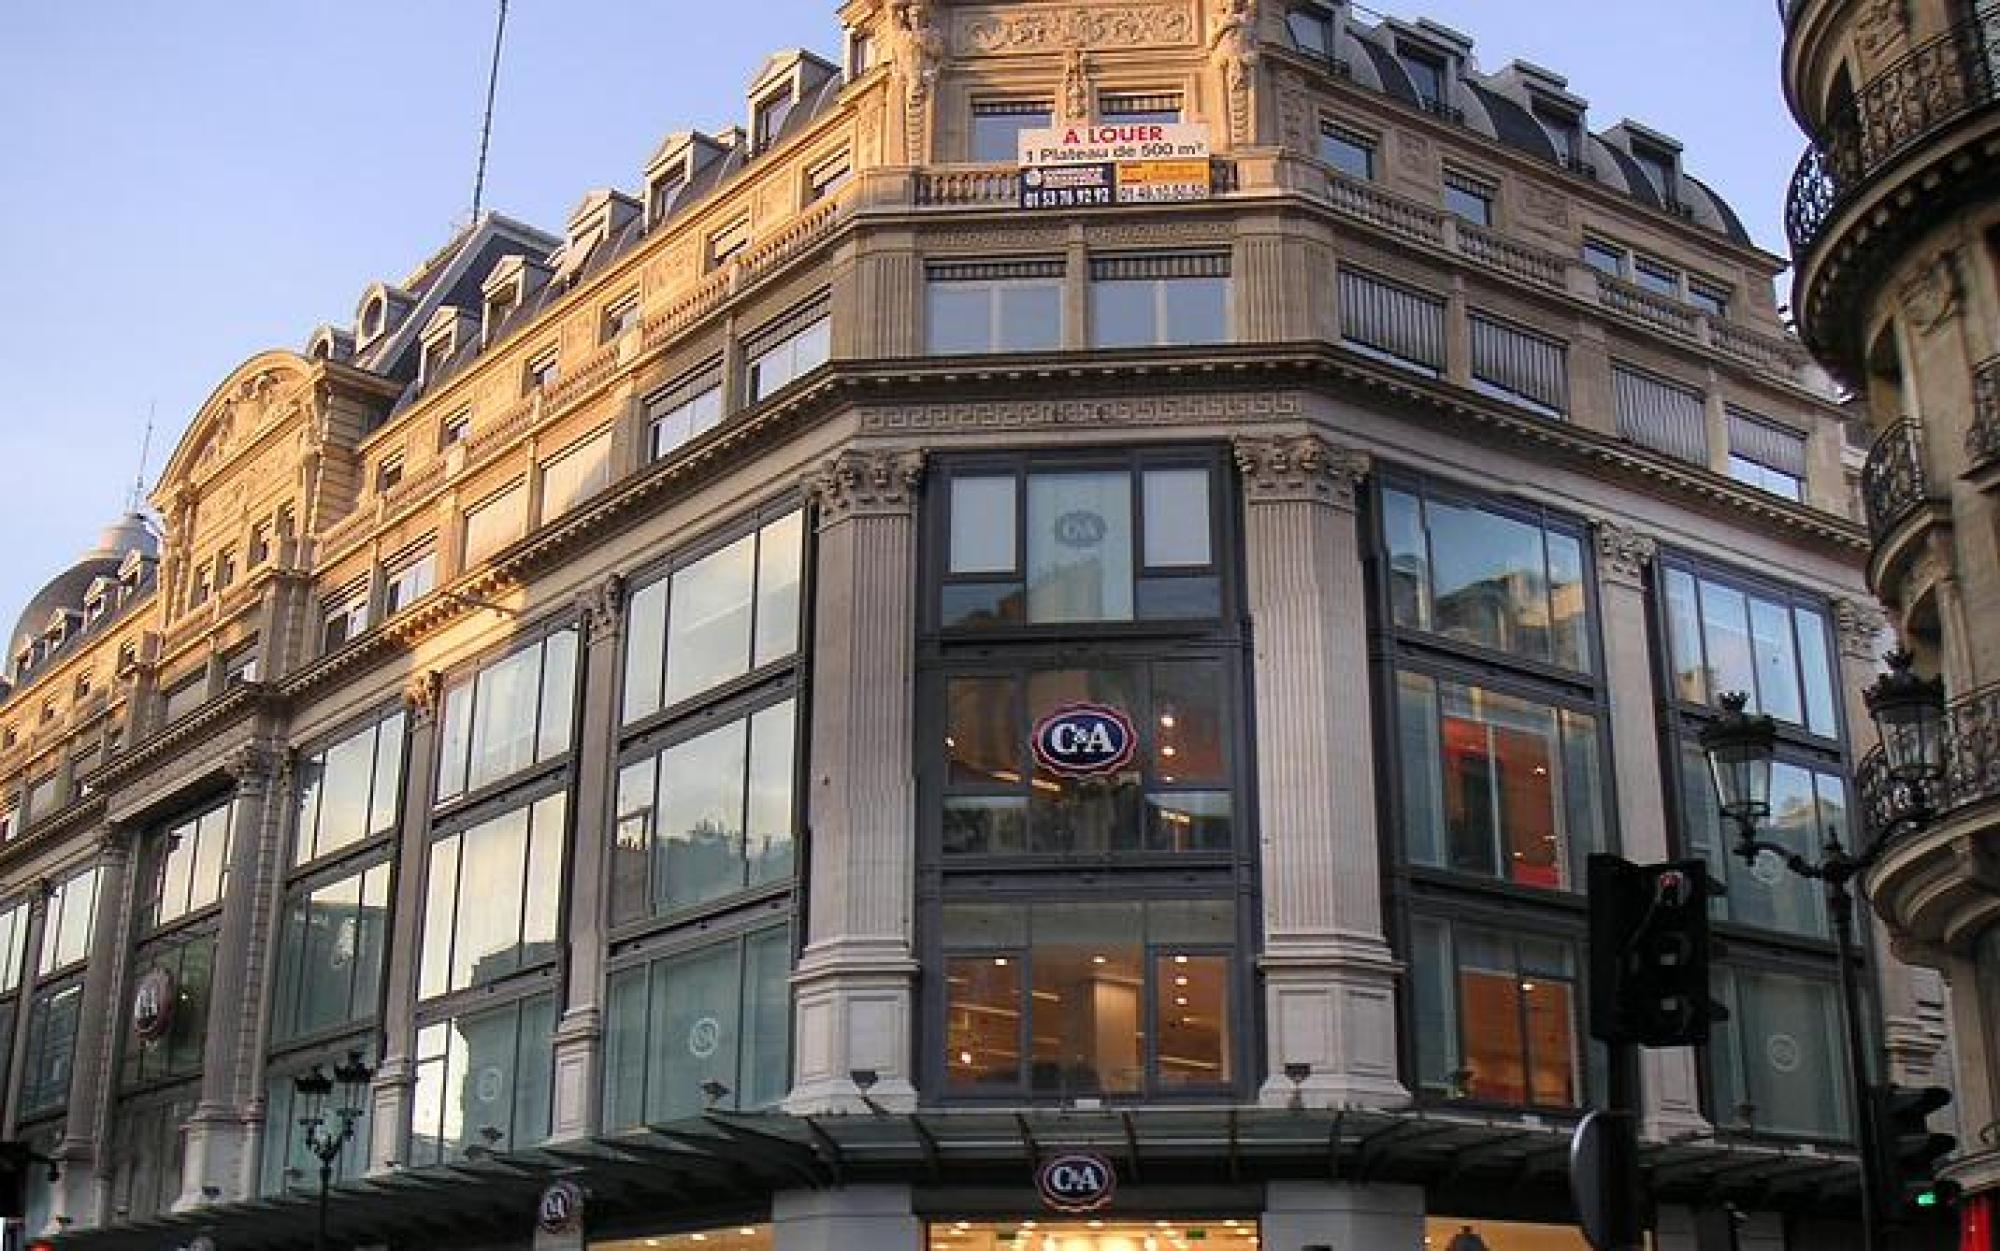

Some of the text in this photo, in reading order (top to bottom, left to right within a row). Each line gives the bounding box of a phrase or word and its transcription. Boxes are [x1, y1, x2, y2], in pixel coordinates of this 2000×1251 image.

[1063, 126, 1163, 144] A LOUER
[1040, 147, 1109, 163] Plateau
[1113, 145, 1135, 158] de
[1141, 143, 1173, 156] 500
[1051, 721, 1115, 754] C&A
[1053, 1166, 1098, 1191] C&A
